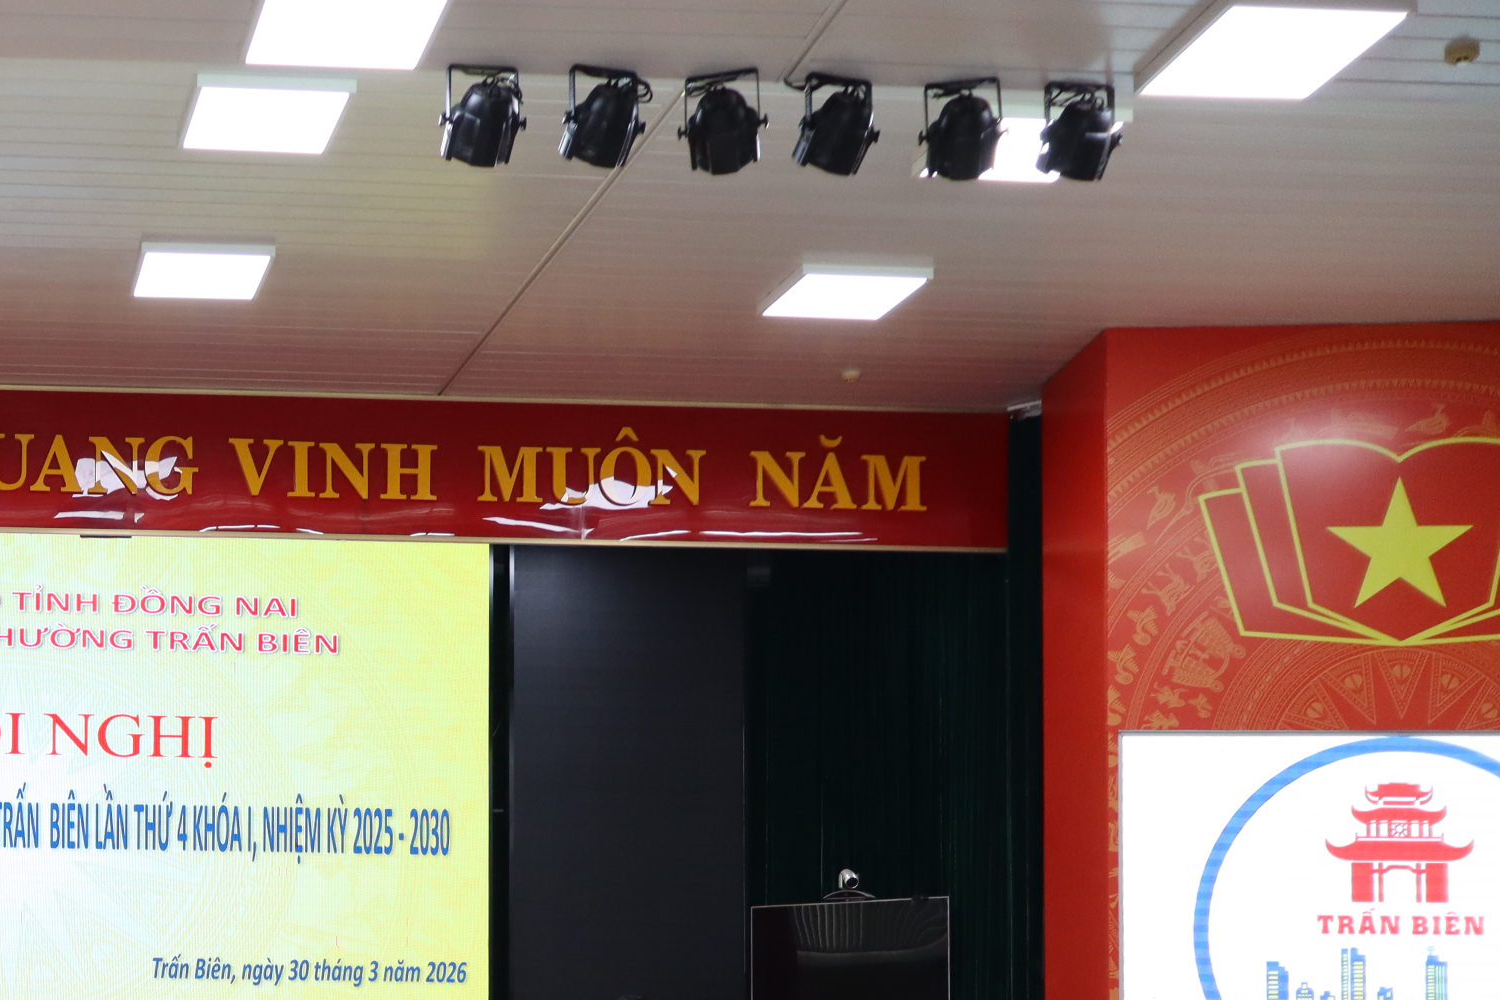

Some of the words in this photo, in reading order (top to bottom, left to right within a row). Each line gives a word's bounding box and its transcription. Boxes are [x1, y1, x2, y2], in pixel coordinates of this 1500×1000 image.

[228, 437, 439, 502] VINH
[477, 426, 707, 507] MUÔN
[749, 434, 928, 512] NĂM
[11, 584, 98, 614] TỈNH
[111, 586, 222, 617] ĐỒNG
[234, 597, 299, 619] NAI
[145, 623, 244, 654] TRẤN
[256, 627, 340, 656] BIÊN
[42, 711, 219, 769] NGHỊ
[49, 789, 89, 850] BIÊN
[95, 783, 129, 851] LẦN
[134, 790, 174, 852] THỨ
[177, 804, 188, 852] 4
[193, 792, 243, 853] KHÓA
[263, 793, 322, 864] NHIỆM
[327, 793, 349, 854] KỲ
[353, 806, 394, 855] 2025
[409, 807, 451, 857] 2030
[1317, 908, 1401, 935] TRẤN
[1411, 911, 1485, 936] BIÊN
[152, 954, 190, 980] Trấn
[194, 957, 237, 983] Biên,
[241, 957, 285, 986] ngày
[288, 959, 310, 982] 30
[314, 959, 364, 987] tháng
[368, 960, 379, 982] 3
[383, 959, 422, 983] năm
[425, 961, 468, 983] 2026
